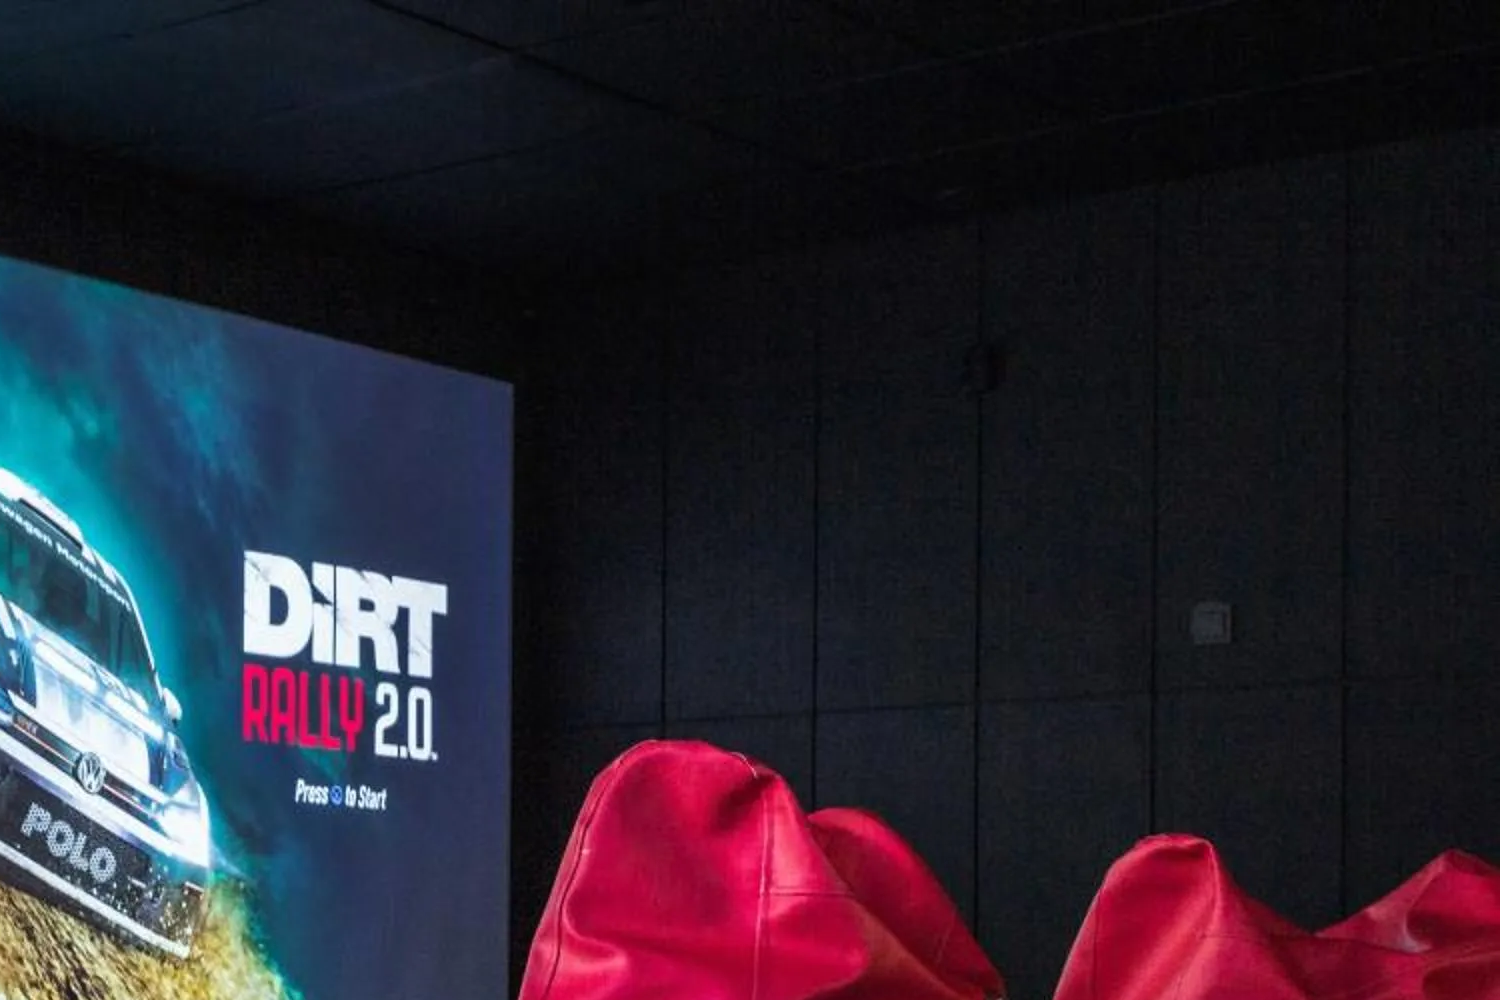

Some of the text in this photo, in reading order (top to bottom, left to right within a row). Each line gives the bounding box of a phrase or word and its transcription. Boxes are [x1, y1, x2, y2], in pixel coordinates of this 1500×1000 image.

[242, 663, 365, 752] RALLY
[294, 777, 388, 811] Press to Start
[20, 801, 118, 884] POLO
